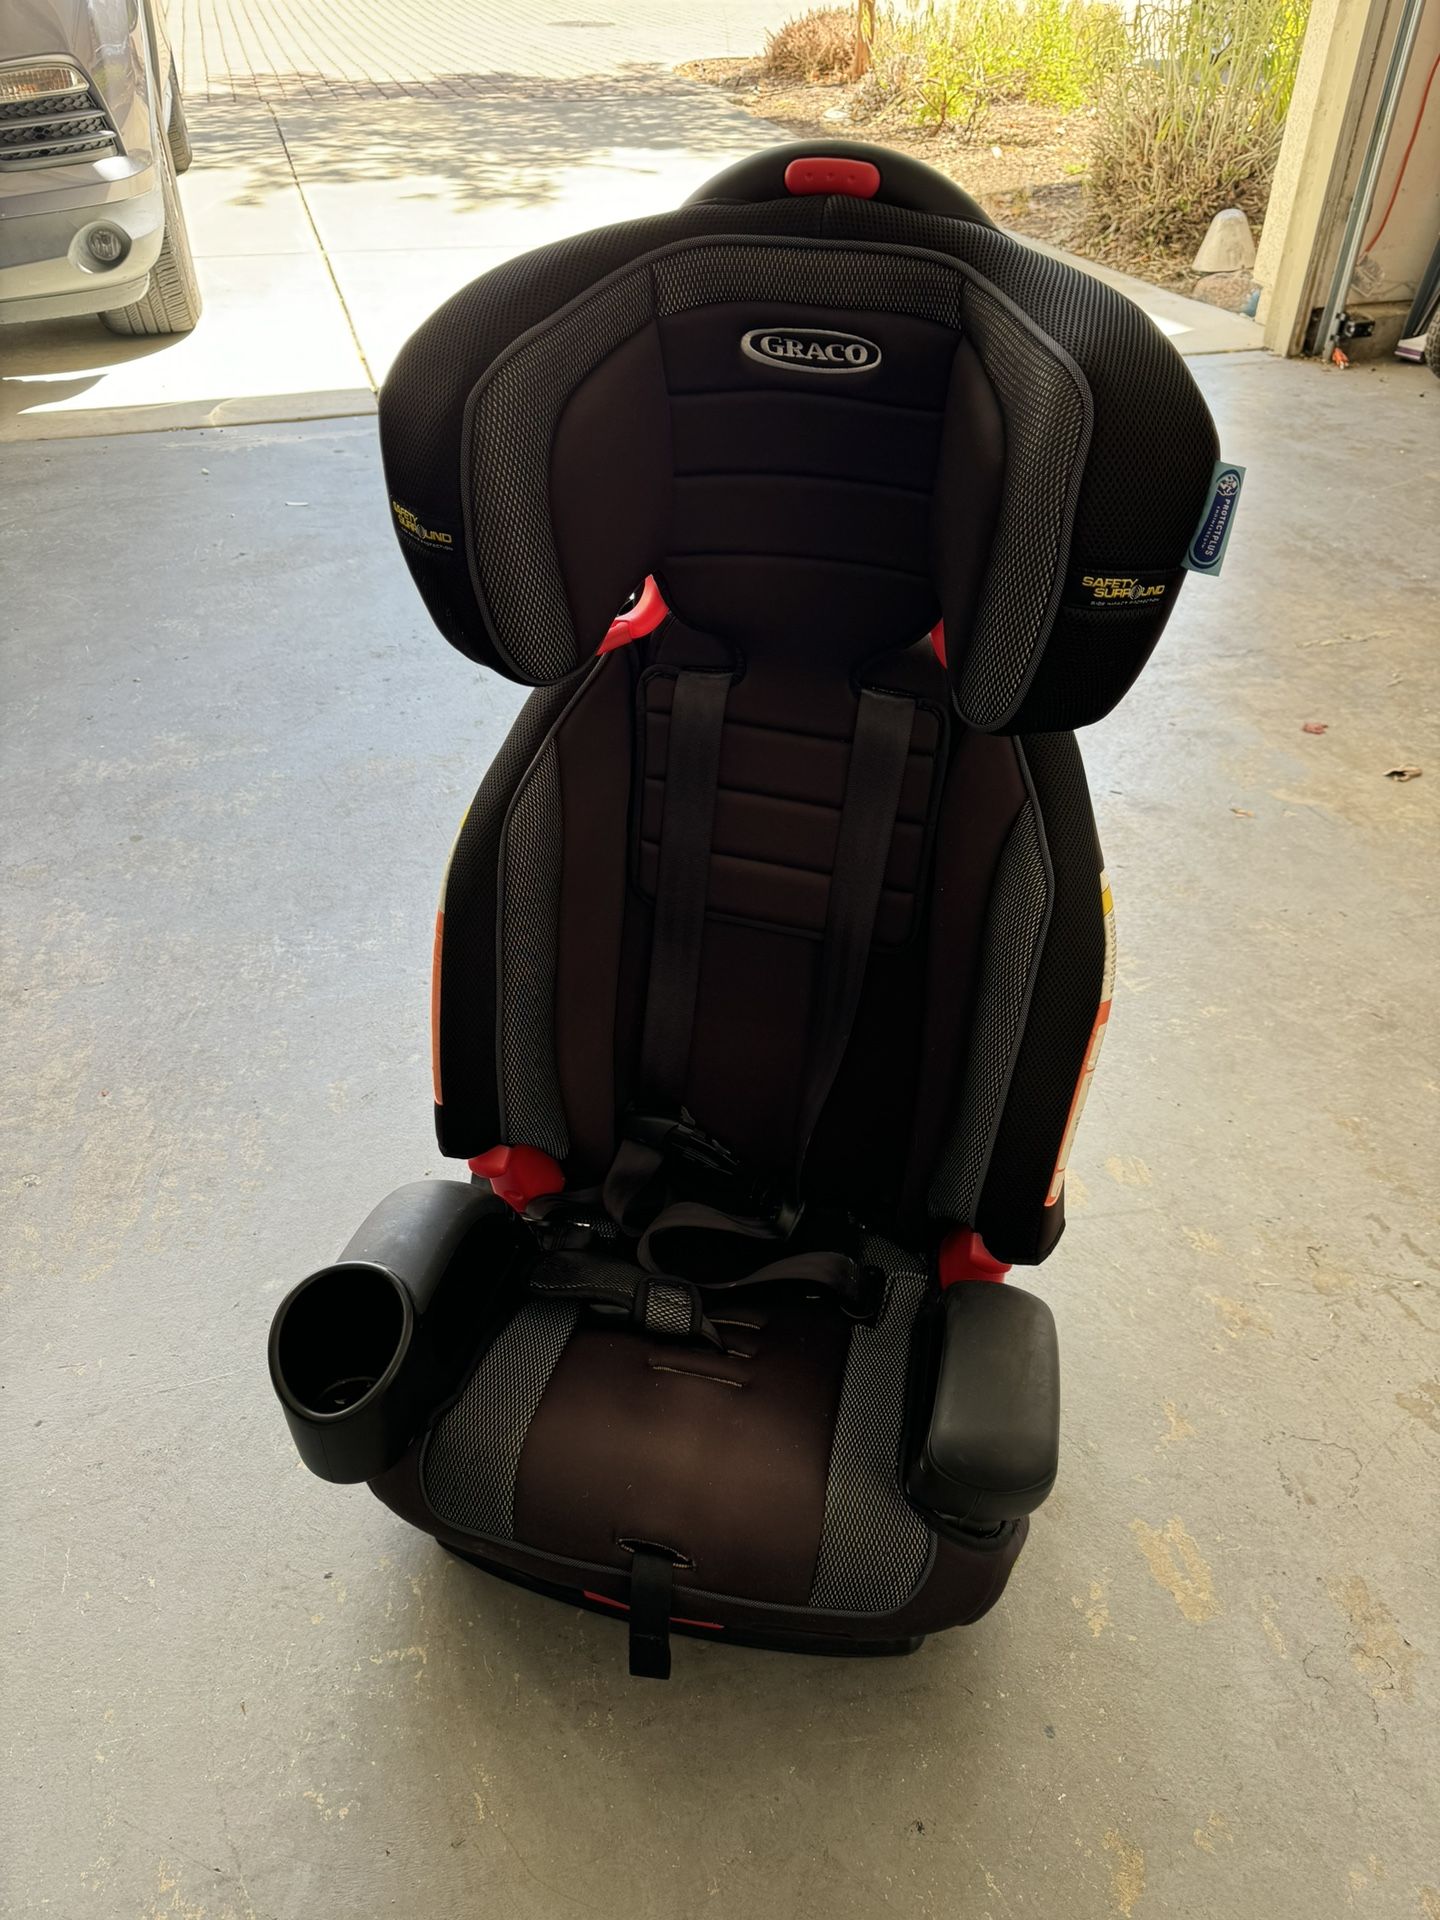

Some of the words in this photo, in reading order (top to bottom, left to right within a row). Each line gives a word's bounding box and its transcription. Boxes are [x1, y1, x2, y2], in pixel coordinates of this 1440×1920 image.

[760, 336, 868, 364] GRACO
[1204, 498, 1231, 556] PROTECTPLUS
[1081, 576, 1139, 588] SAFETY
[1093, 585, 1165, 600] SURROUND
